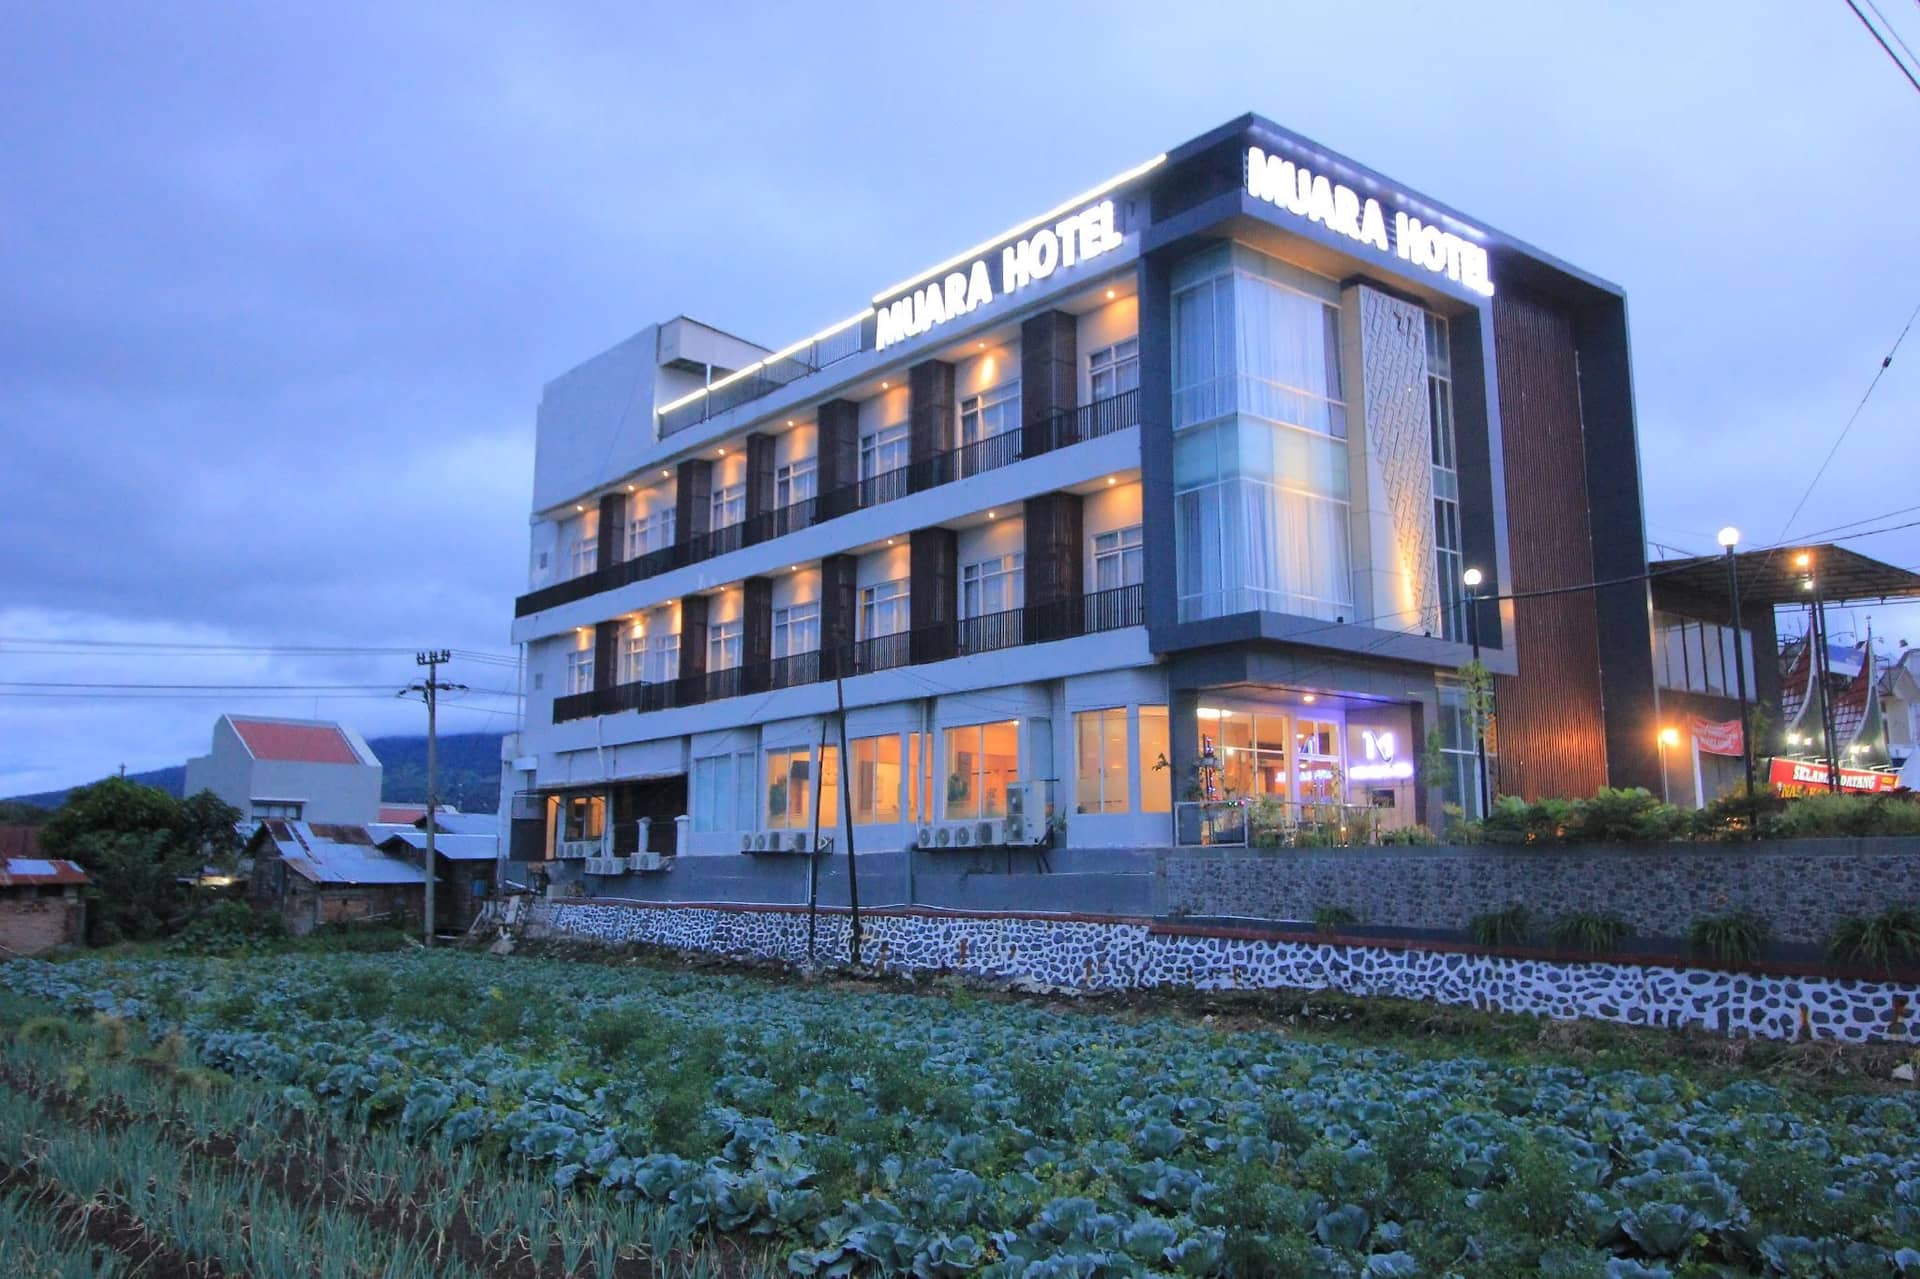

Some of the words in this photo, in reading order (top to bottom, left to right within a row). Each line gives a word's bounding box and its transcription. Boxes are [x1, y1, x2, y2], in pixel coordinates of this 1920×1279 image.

[876, 260, 993, 352] MUARA
[1002, 200, 1123, 294] HOTEL
[1247, 146, 1389, 251] MUARA
[1395, 211, 1495, 297] HOTEL
[1840, 775, 1876, 790] DATANG
